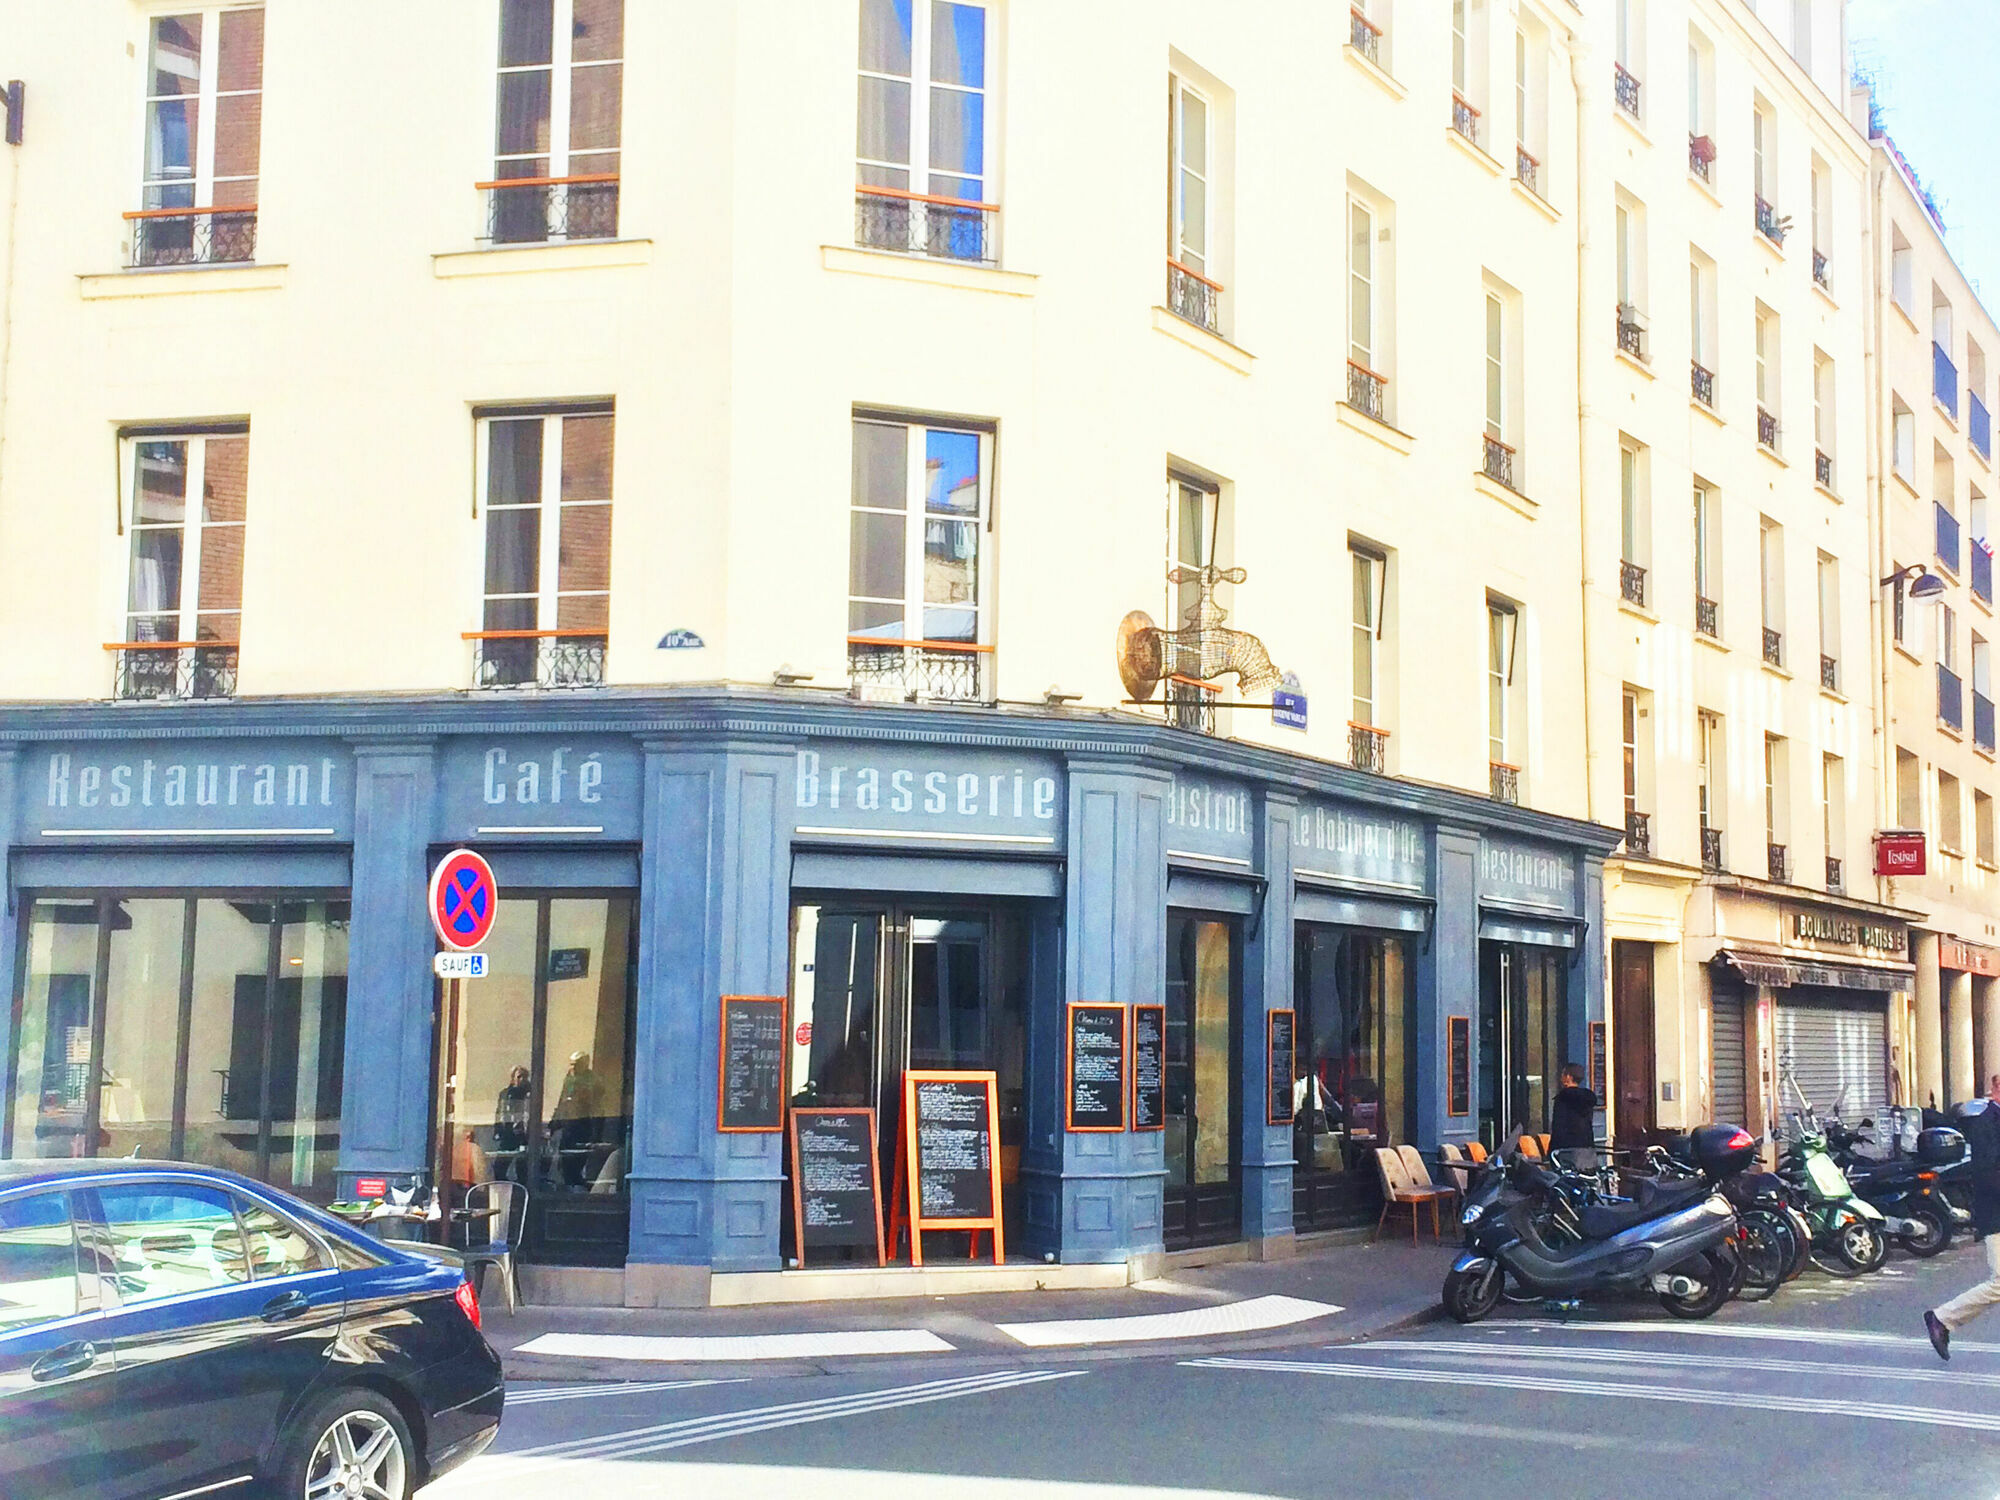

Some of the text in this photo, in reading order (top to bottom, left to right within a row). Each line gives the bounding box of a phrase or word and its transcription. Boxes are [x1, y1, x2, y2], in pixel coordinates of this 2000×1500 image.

[47, 753, 337, 807] Restaurant
[484, 747, 602, 804] Café
[796, 750, 1056, 819] Brasserie
[1293, 806, 1417, 863] Le Robinet d'Or
[1481, 838, 1563, 891] Restaurant
[1800, 914, 1858, 943] BOULANGER
[442, 958, 470, 971] SAUF
